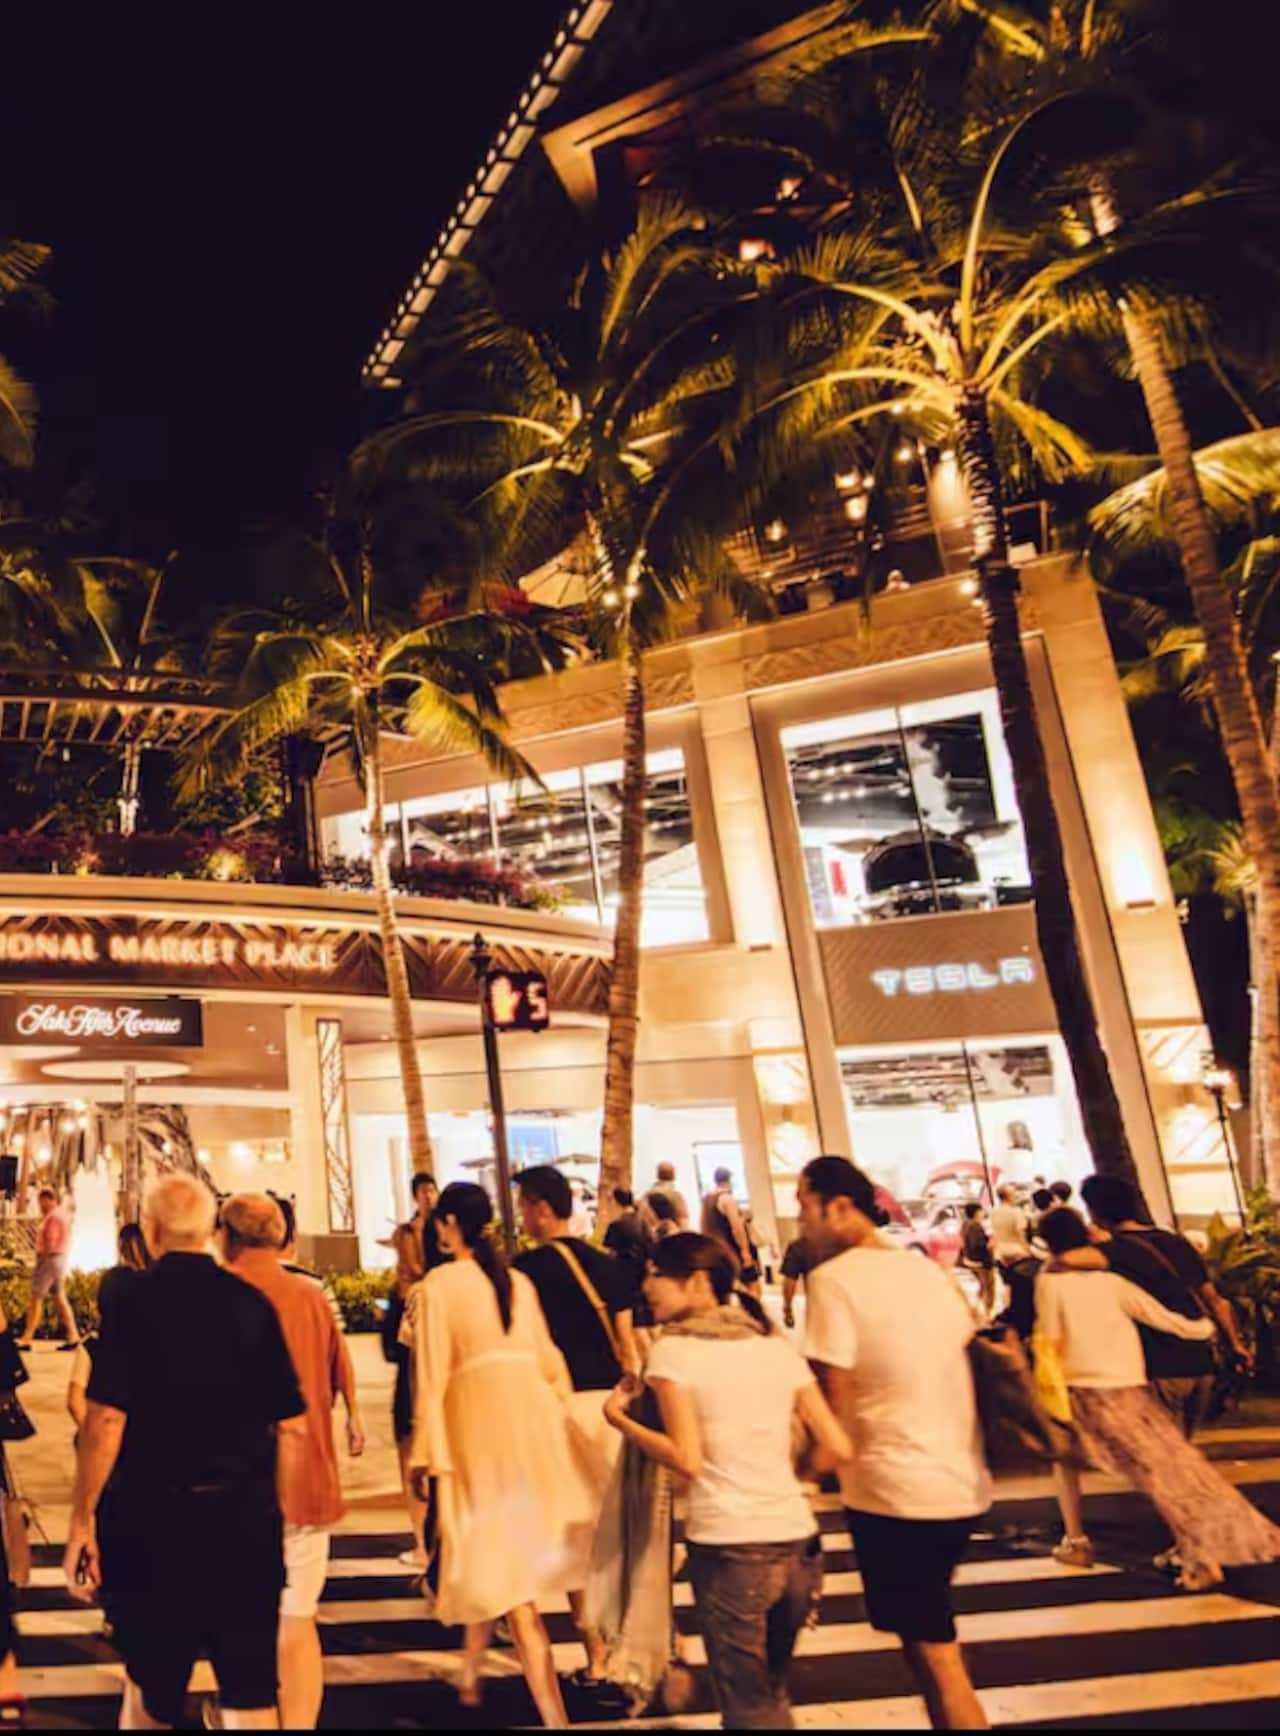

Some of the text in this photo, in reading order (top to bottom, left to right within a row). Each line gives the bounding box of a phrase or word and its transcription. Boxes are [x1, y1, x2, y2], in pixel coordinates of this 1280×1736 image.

[109, 935, 237, 965] MARKET
[243, 941, 338, 969] PLACE
[871, 957, 1035, 997] TESLA
[527, 981, 547, 1021] 5
[16, 1004, 182, 1037] Saks Fifth Avenue
